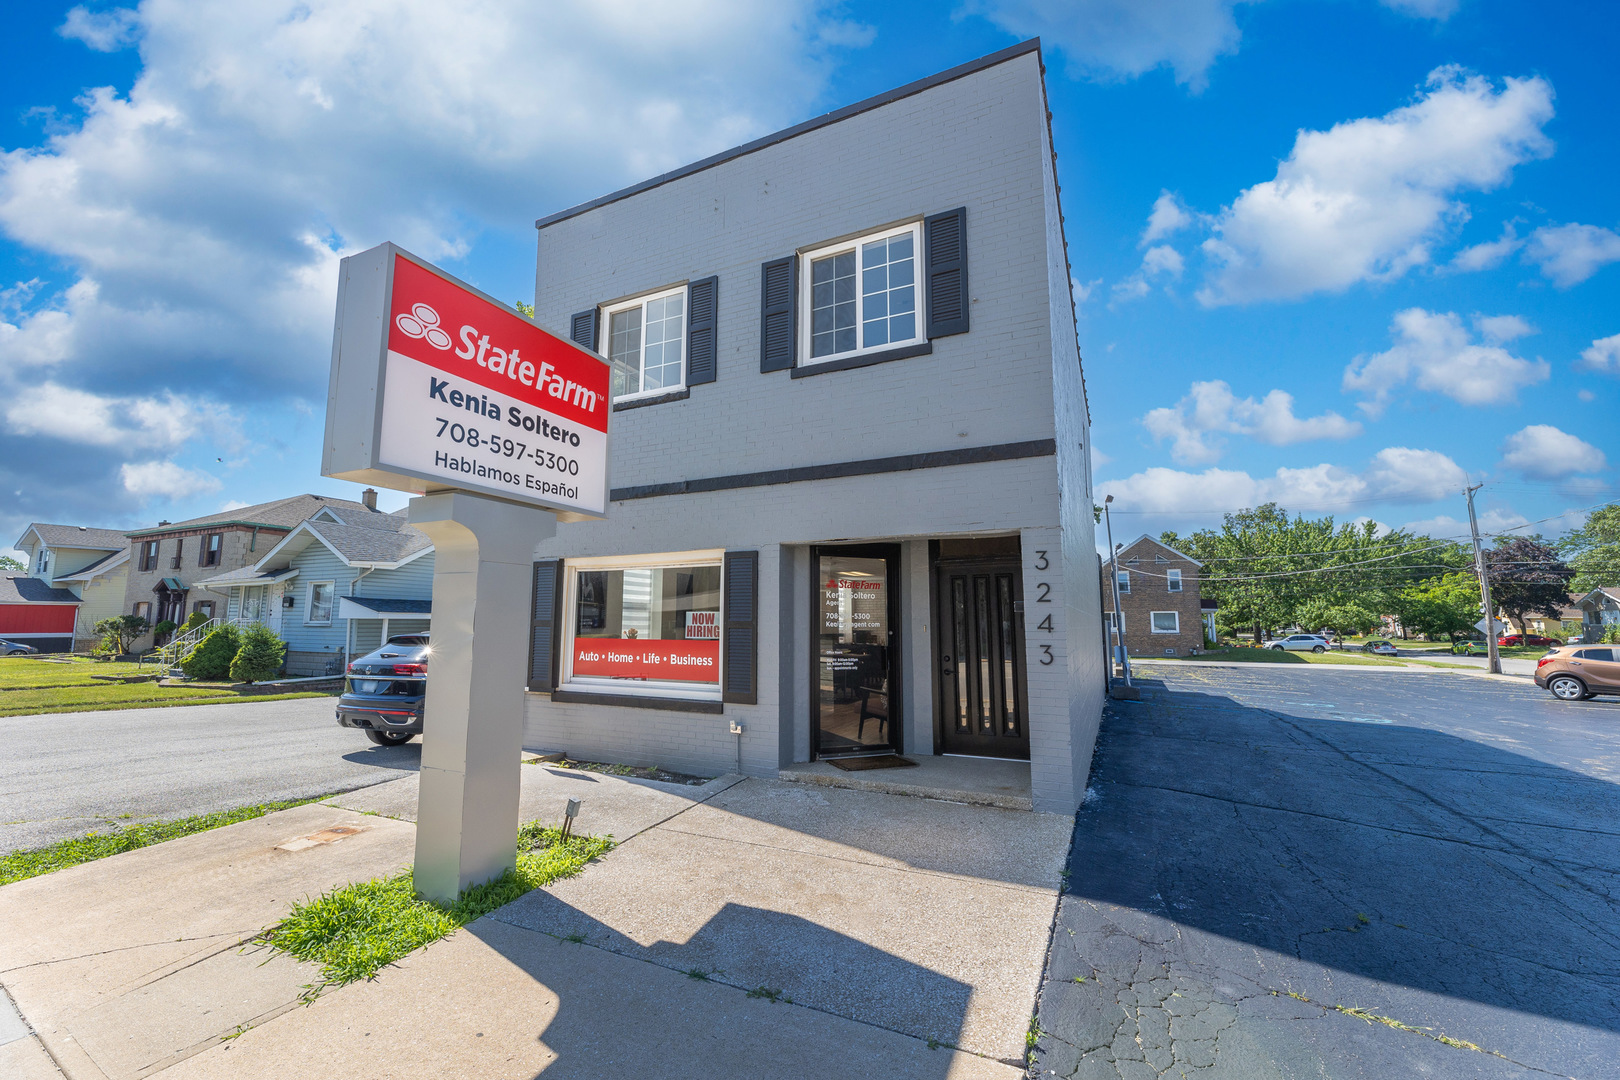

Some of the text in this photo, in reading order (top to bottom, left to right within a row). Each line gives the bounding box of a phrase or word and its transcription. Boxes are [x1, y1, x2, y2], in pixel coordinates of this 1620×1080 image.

[429, 377, 581, 447] Kenia Soltero
[435, 417, 579, 476] 708-597-5300
[434, 450, 578, 500] Hablamos Español
[825, 591, 876, 600] Keni Soltero
[691, 612, 715, 625] NOW
[825, 612, 871, 620] 708--5300
[686, 625, 720, 638] HIRING
[578, 650, 713, 666] Auto Home Life Business
